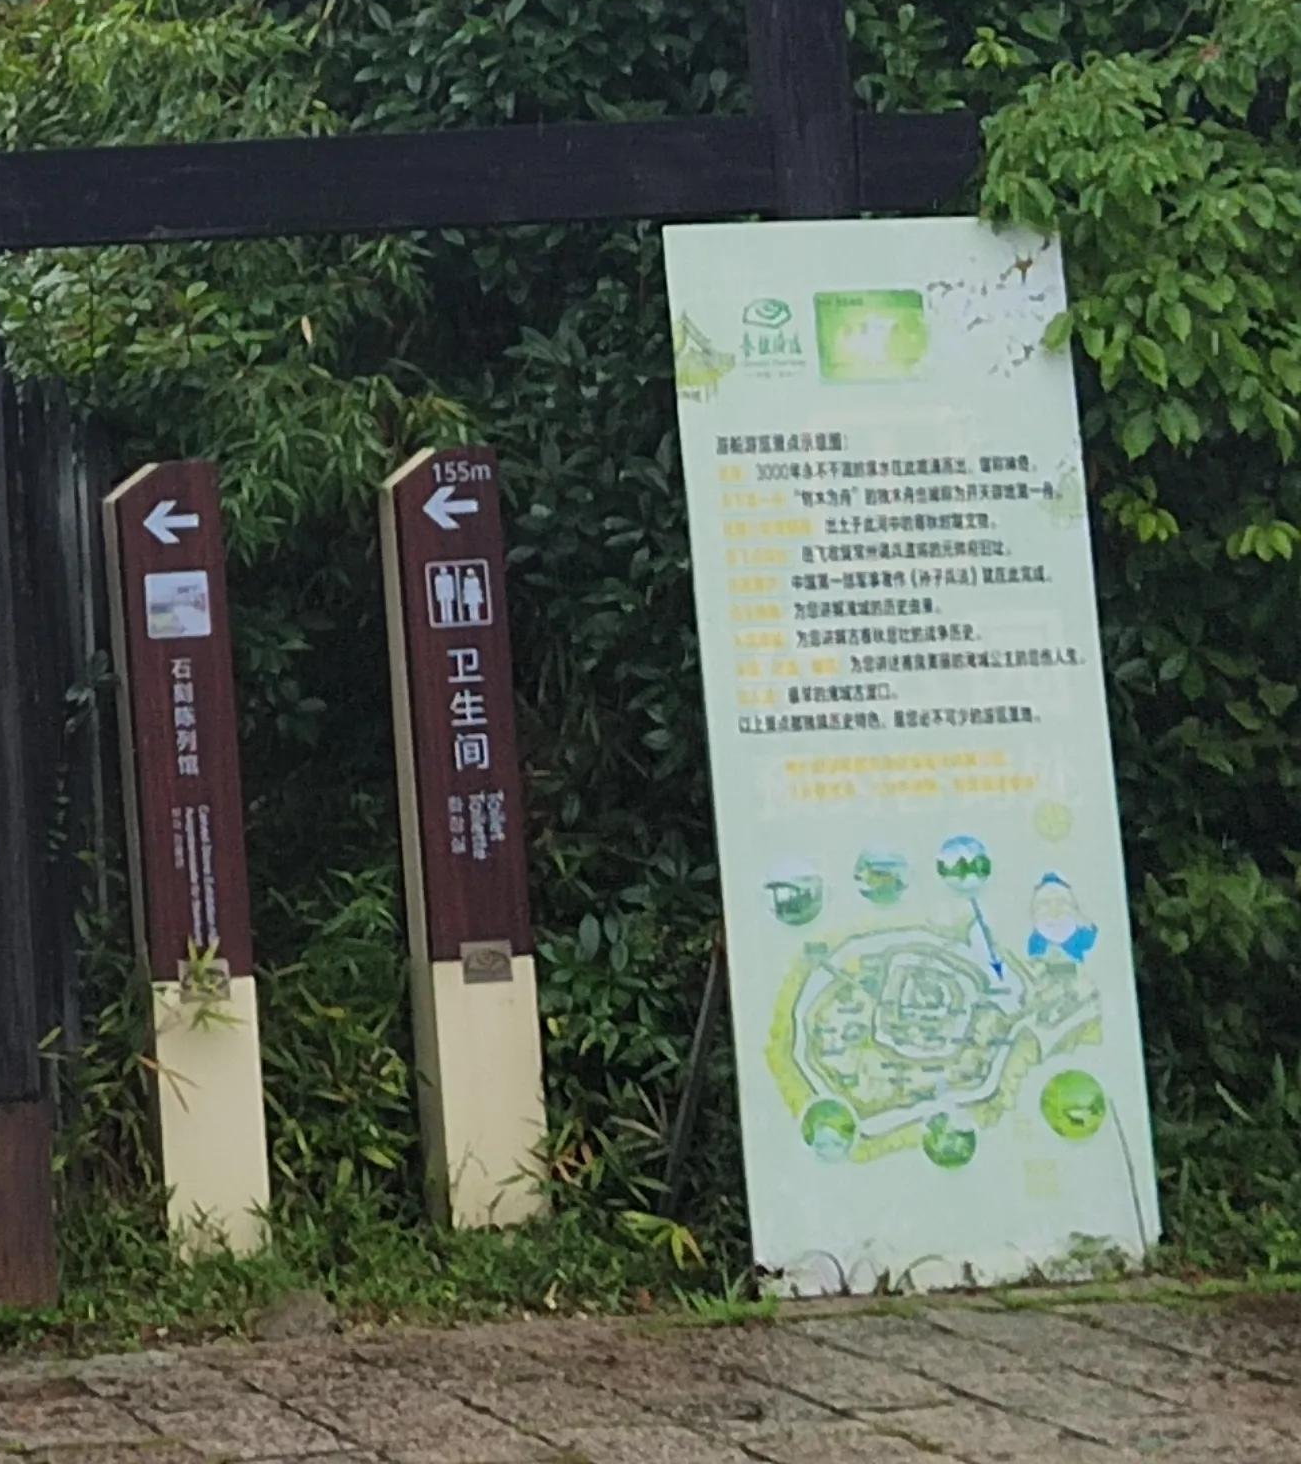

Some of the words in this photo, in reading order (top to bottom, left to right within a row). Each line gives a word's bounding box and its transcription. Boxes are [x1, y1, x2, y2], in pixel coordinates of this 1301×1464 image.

[433, 460, 492, 484] 155m
[447, 647, 490, 773] 卫生间
